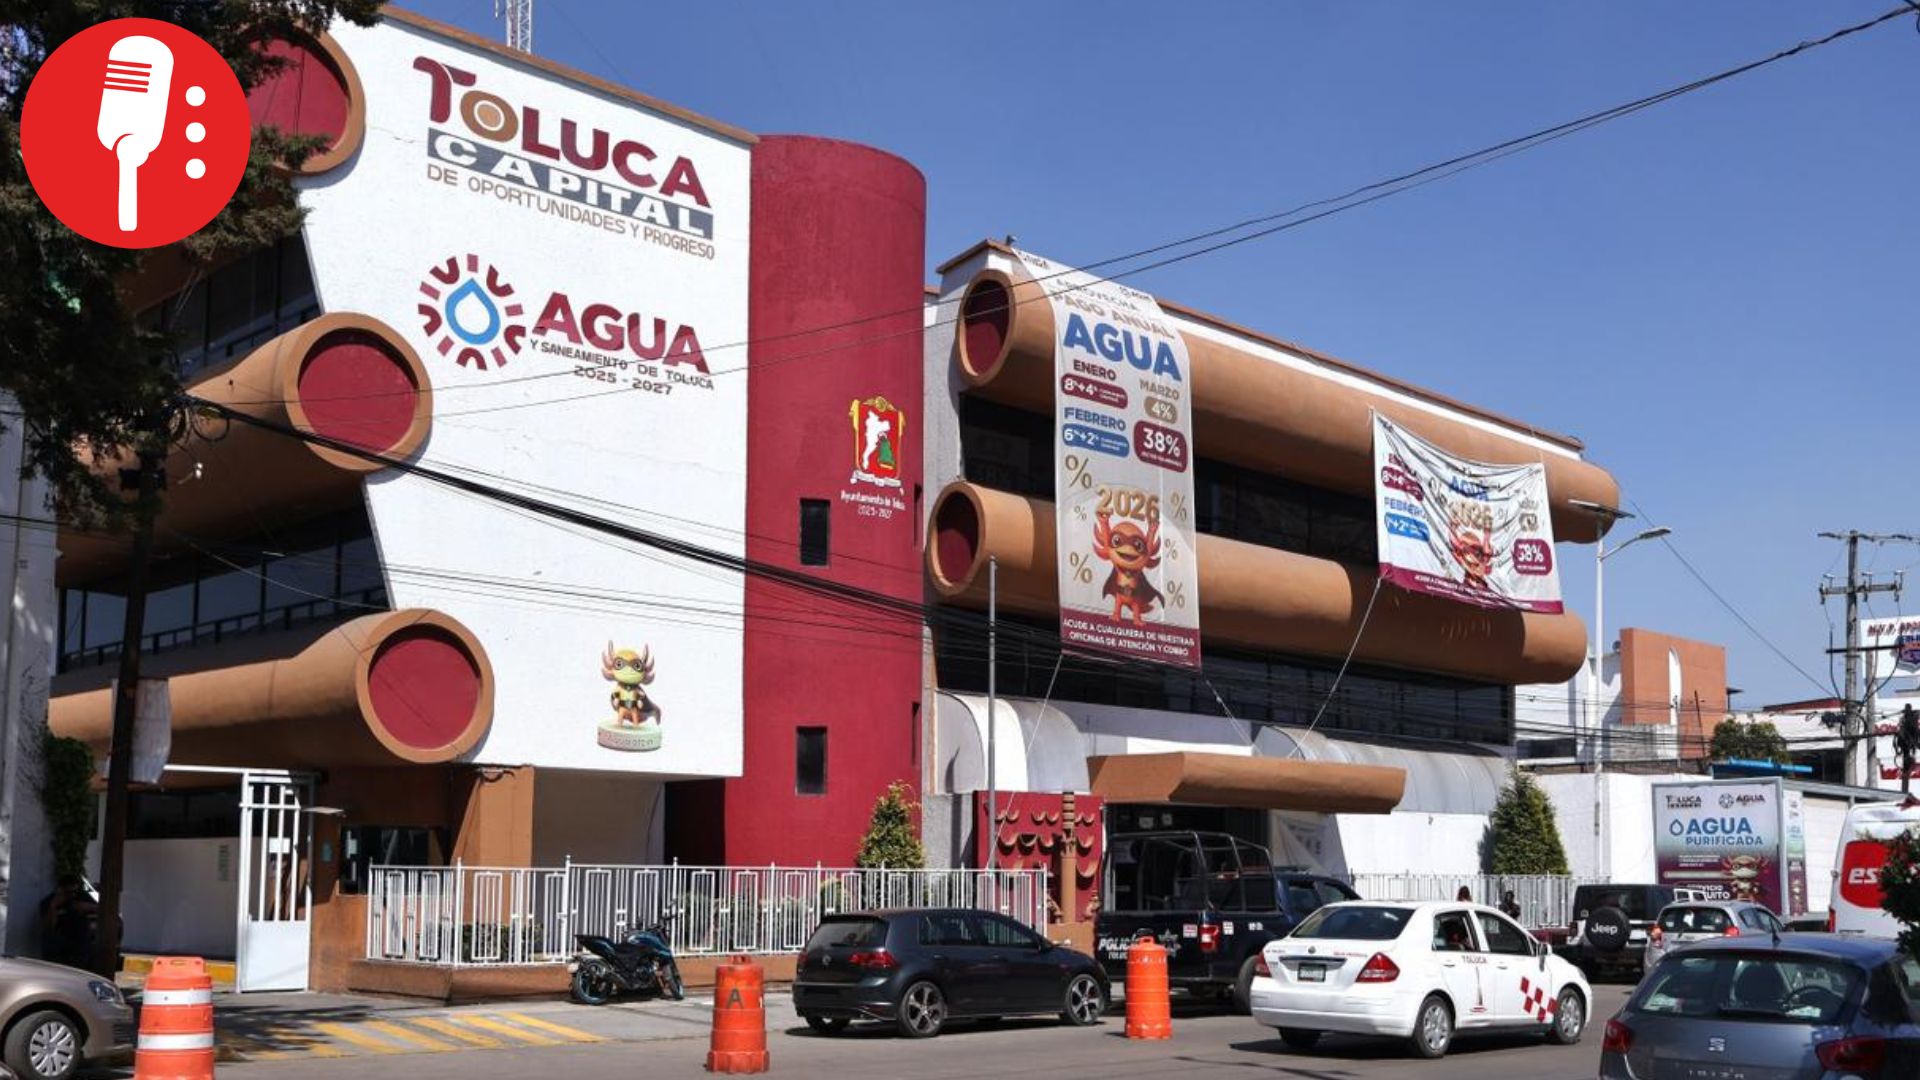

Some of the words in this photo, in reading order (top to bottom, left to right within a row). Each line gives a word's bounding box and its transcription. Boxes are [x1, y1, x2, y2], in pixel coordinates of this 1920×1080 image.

[413, 56, 711, 208] TOLUCA
[434, 134, 705, 236] CAPITAL
[427, 164, 458, 186] DE
[468, 176, 626, 234] OPORTUNIDADES
[630, 222, 641, 240] Y
[643, 228, 715, 260] PROGRESO
[532, 291, 711, 375] AGUA
[1063, 313, 1182, 381] AGUA
[530, 338, 538, 350] Y
[540, 341, 628, 370] SANEAMIENTO
[637, 364, 658, 378] DE
[665, 369, 715, 390] TOLUCA
[1073, 359, 1117, 381] ENERO
[574, 365, 617, 384] 2025
[632, 379, 673, 395] 2027
[1139, 378, 1181, 401] MARZO
[1064, 407, 1127, 431] FEBRERO
[1151, 401, 1174, 418] 4%
[1143, 427, 1181, 458] 38%
[1096, 488, 1161, 522] 2026
[1686, 816, 1753, 835] AGUA
[1686, 835, 1764, 846] PURIFICADA
[1098, 934, 1138, 951] POLIC
[1591, 922, 1618, 936] Jeep
